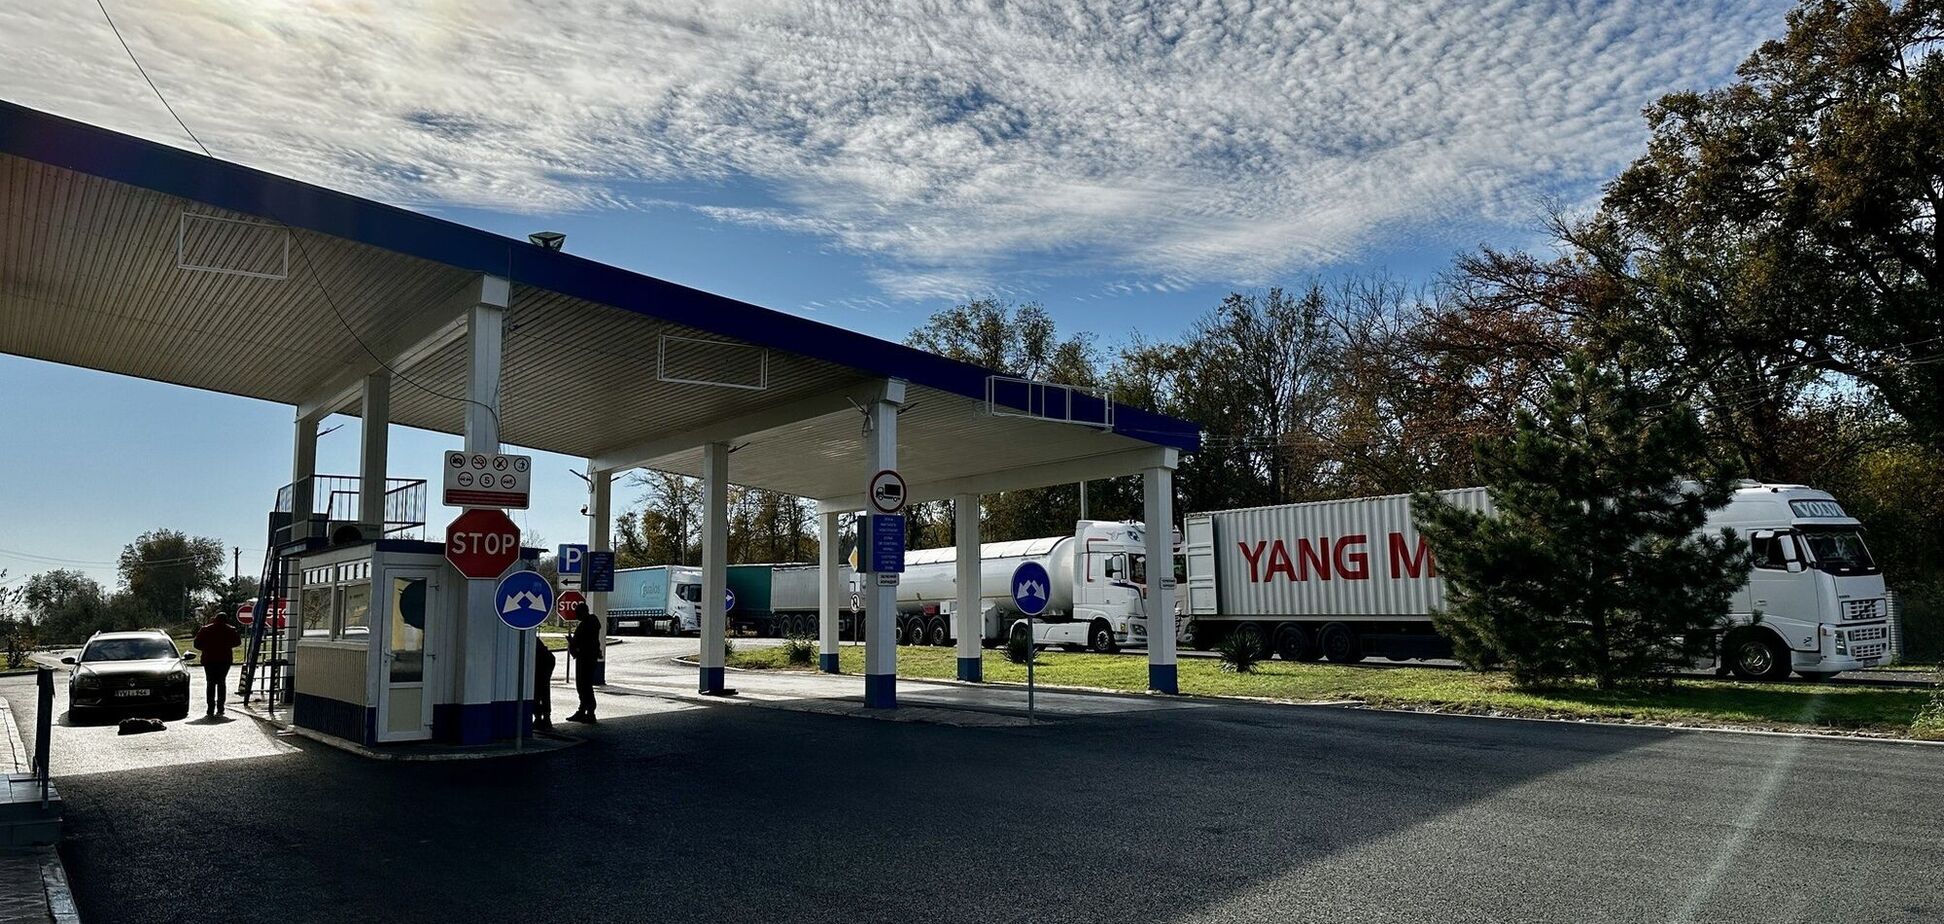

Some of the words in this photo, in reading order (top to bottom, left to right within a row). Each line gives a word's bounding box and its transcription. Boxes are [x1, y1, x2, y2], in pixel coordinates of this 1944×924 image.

[484, 476, 490, 485] 5
[1792, 501, 1847, 517] VOLVO
[452, 532, 516, 555] STOP
[566, 547, 582, 571] P
[1238, 534, 1370, 583] YANG
[1388, 532, 1437, 579] M
[558, 600, 585, 611] STO
